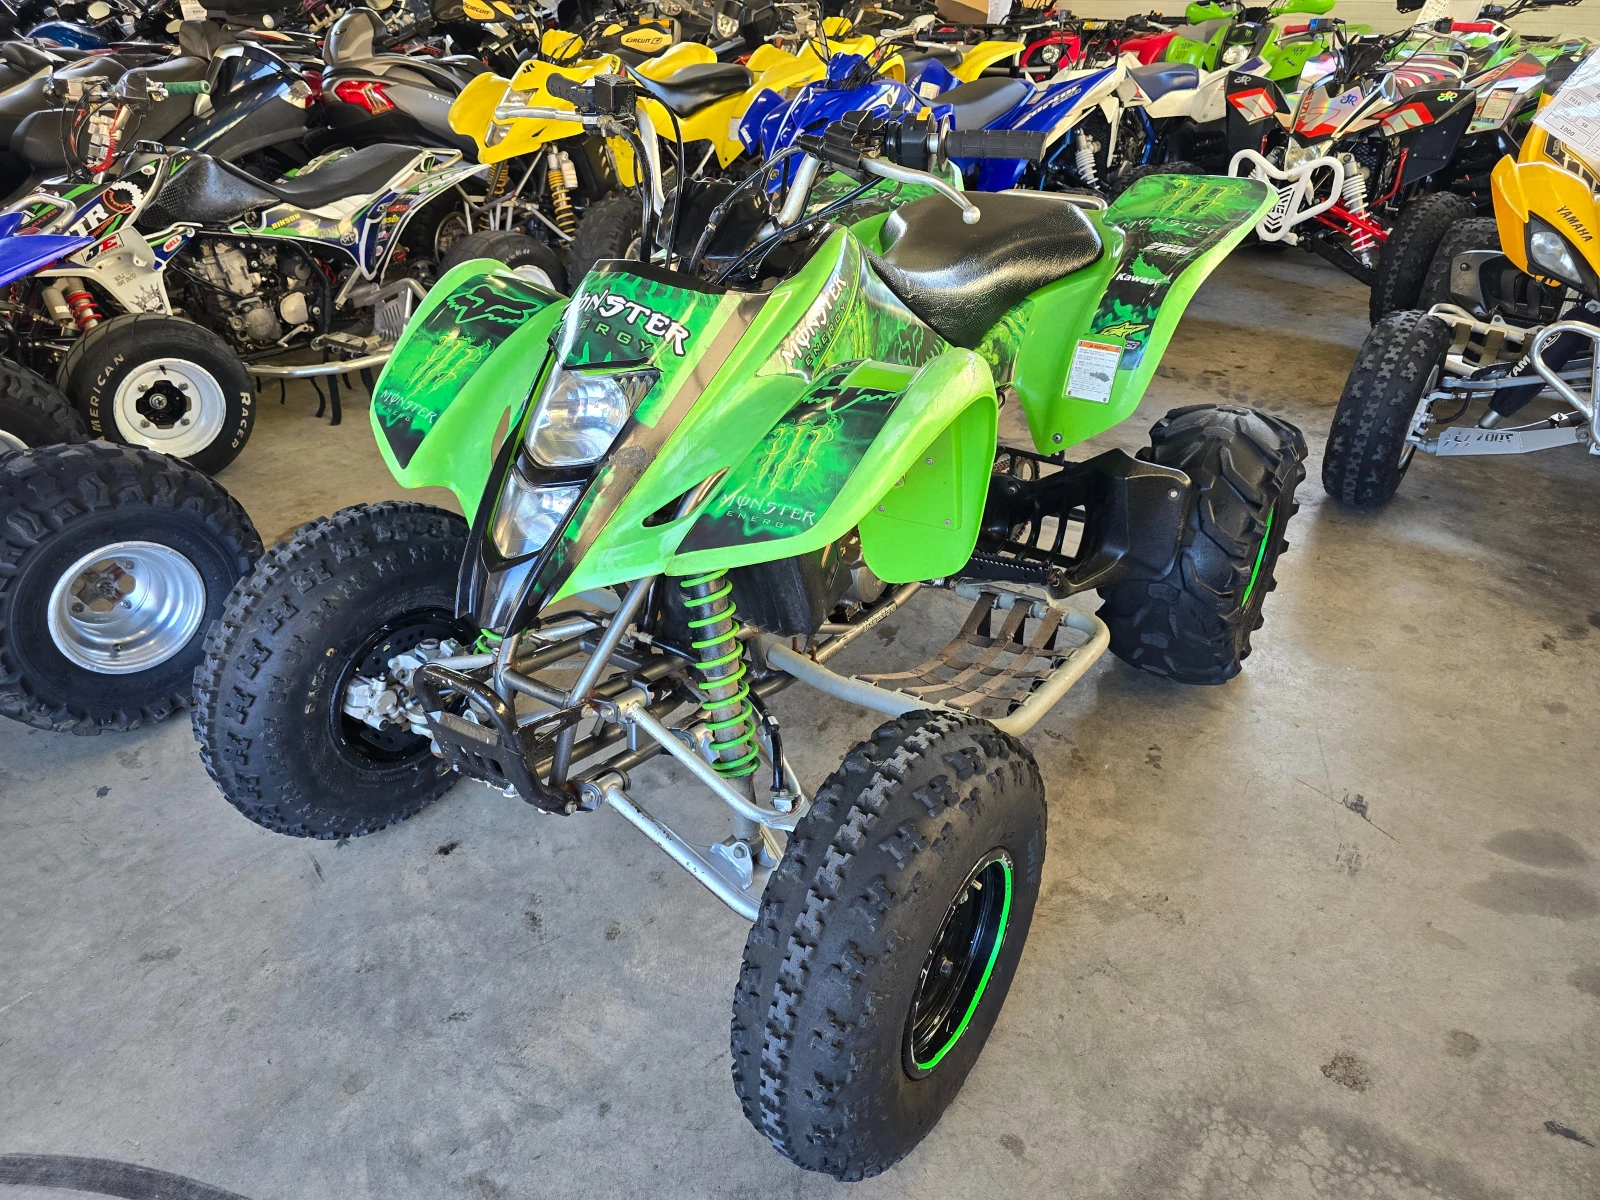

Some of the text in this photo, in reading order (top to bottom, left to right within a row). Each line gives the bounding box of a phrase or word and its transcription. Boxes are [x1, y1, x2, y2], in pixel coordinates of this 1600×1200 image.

[1556, 205, 1594, 243] YAMAHA
[231, 391, 252, 448] RACER
[380, 389, 437, 424] MONSTER
[720, 493, 816, 526] MONSTER
[726, 510, 797, 532] ENERGY
